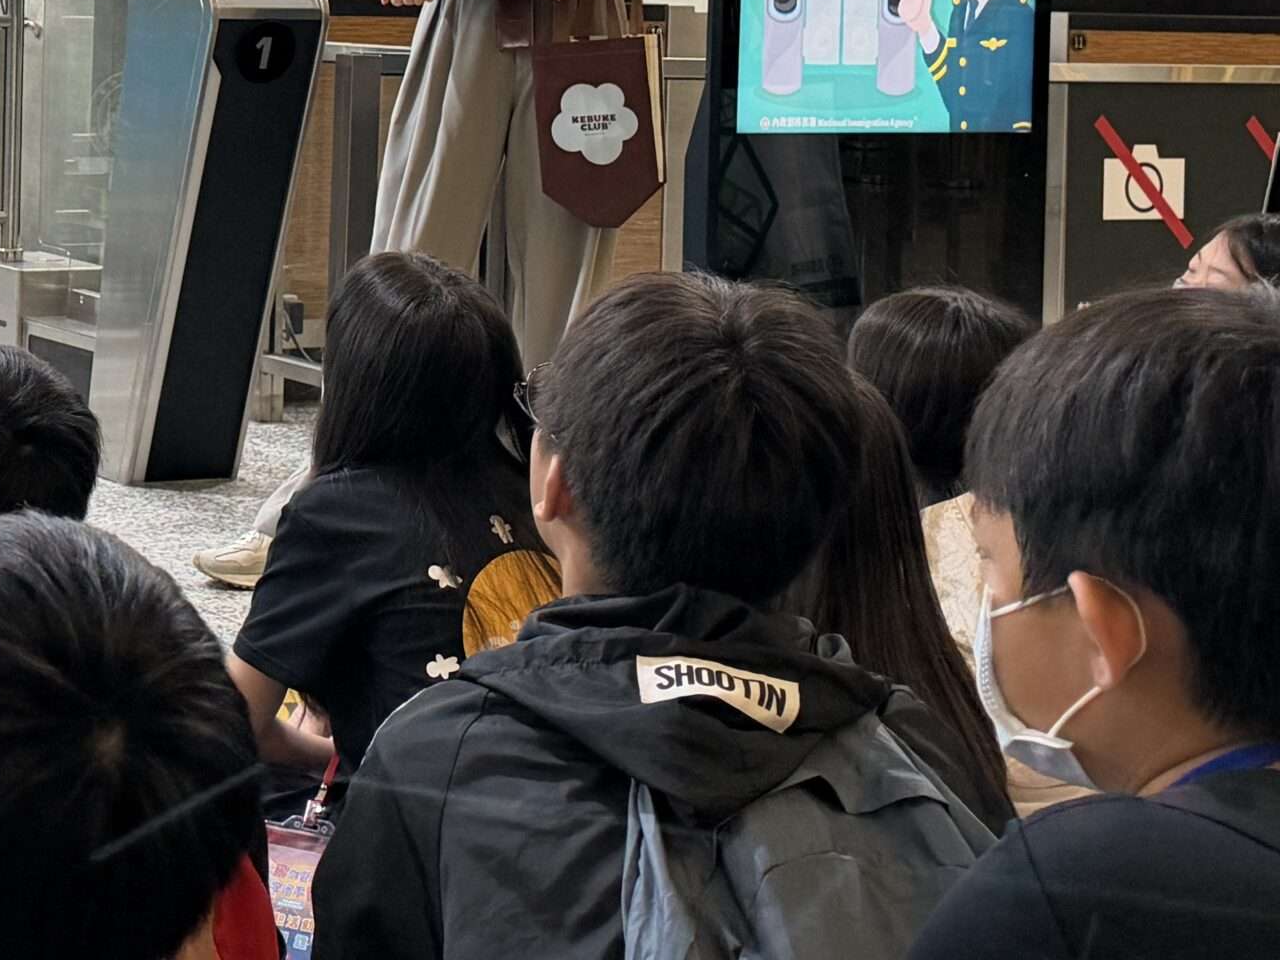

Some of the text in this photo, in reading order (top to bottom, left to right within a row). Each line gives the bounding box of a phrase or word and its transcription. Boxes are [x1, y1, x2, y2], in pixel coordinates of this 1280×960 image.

[256, 36, 272, 69] 1
[572, 114, 616, 124] KEBUKE
[581, 123, 608, 132] CLUB
[654, 664, 786, 717] SHOOTIN
